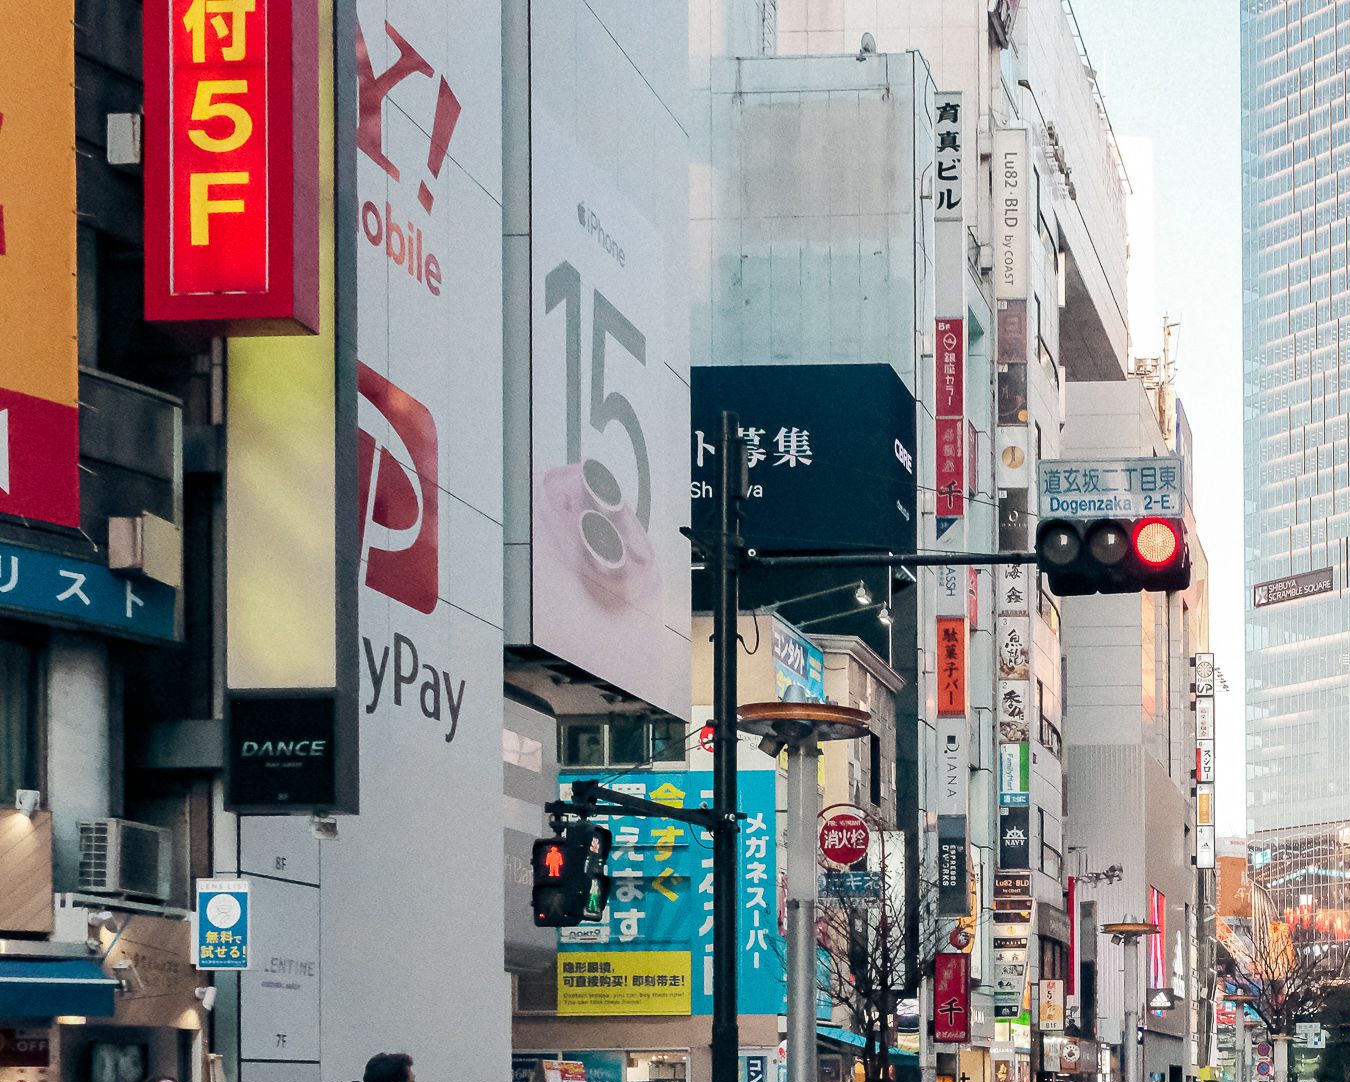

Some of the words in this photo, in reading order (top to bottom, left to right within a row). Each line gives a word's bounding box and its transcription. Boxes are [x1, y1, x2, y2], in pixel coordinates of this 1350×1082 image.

[356, 200, 442, 296] obile
[586, 208, 626, 268] iPhone
[1004, 249, 1014, 286] COAST
[545, 260, 651, 534] 15
[894, 438, 913, 475] CBRE
[1043, 466, 1177, 494] 道玄坂二丁目東
[1050, 496, 1132, 513] Dogenzaka
[1144, 495, 1176, 510] 2-E.
[1268, 579, 1297, 594] SHIBUYA
[1268, 586, 1303, 602] SCRAMBLE
[1303, 579, 1332, 594] SQUARE
[943, 628, 959, 705] 駄菓子バー
[362, 632, 466, 743] yPay
[242, 741, 327, 757] DANCE
[1203, 750, 1212, 780] スシロー
[824, 829, 866, 849] 消火栓
[745, 812, 769, 969] メガネスーパー
[201, 946, 247, 959] 試せる!
[206, 931, 242, 944] 無料で
